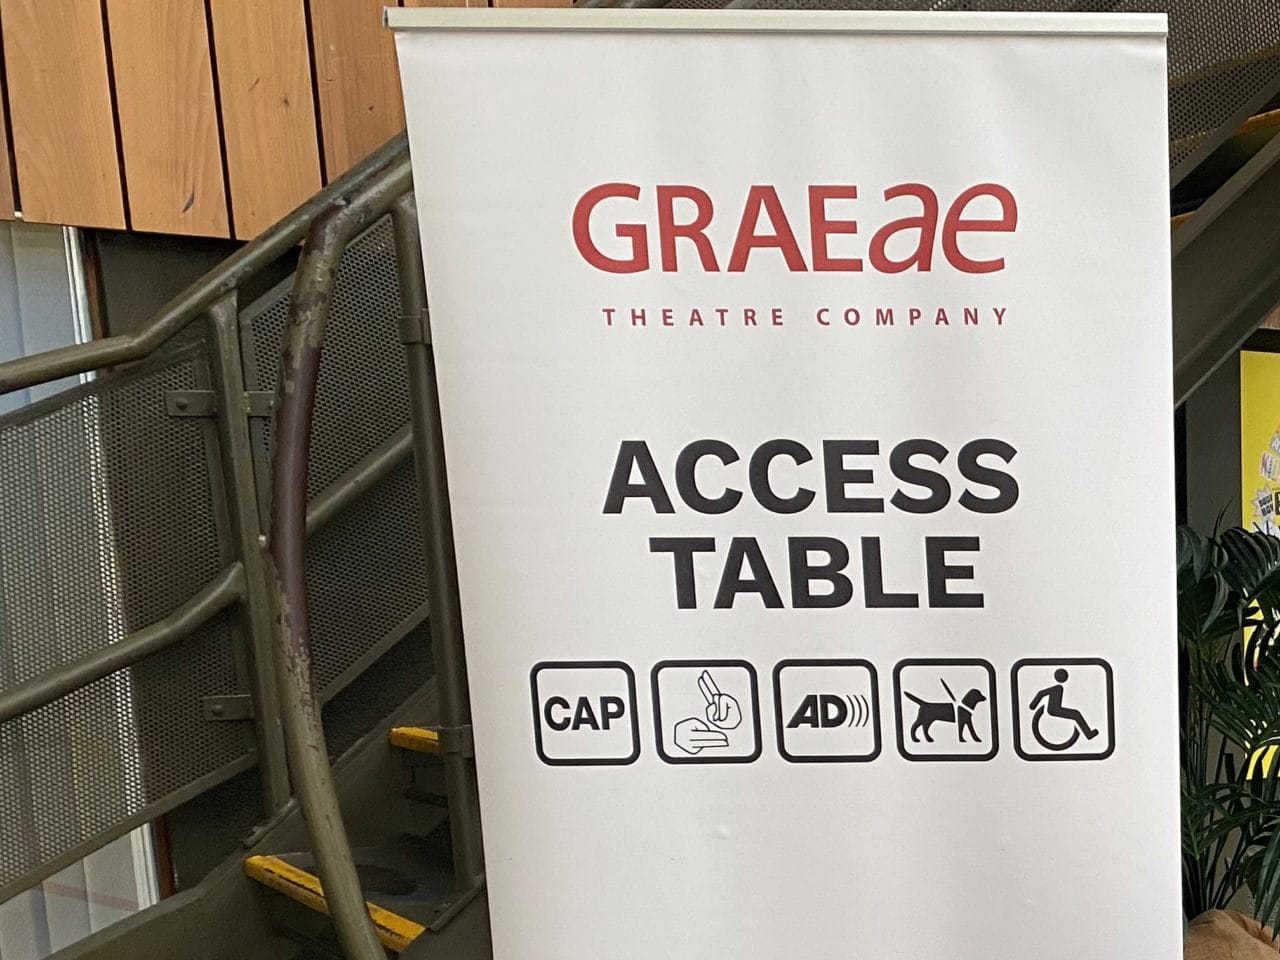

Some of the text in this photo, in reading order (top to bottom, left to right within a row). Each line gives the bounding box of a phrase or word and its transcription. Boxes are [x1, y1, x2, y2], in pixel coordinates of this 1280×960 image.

[572, 182, 1018, 274] GRAEae
[602, 306, 1009, 327] THEATRE COMPANY
[602, 438, 1020, 514] ACCESS
[649, 536, 986, 610] TABLE
[543, 695, 626, 733] CAP
